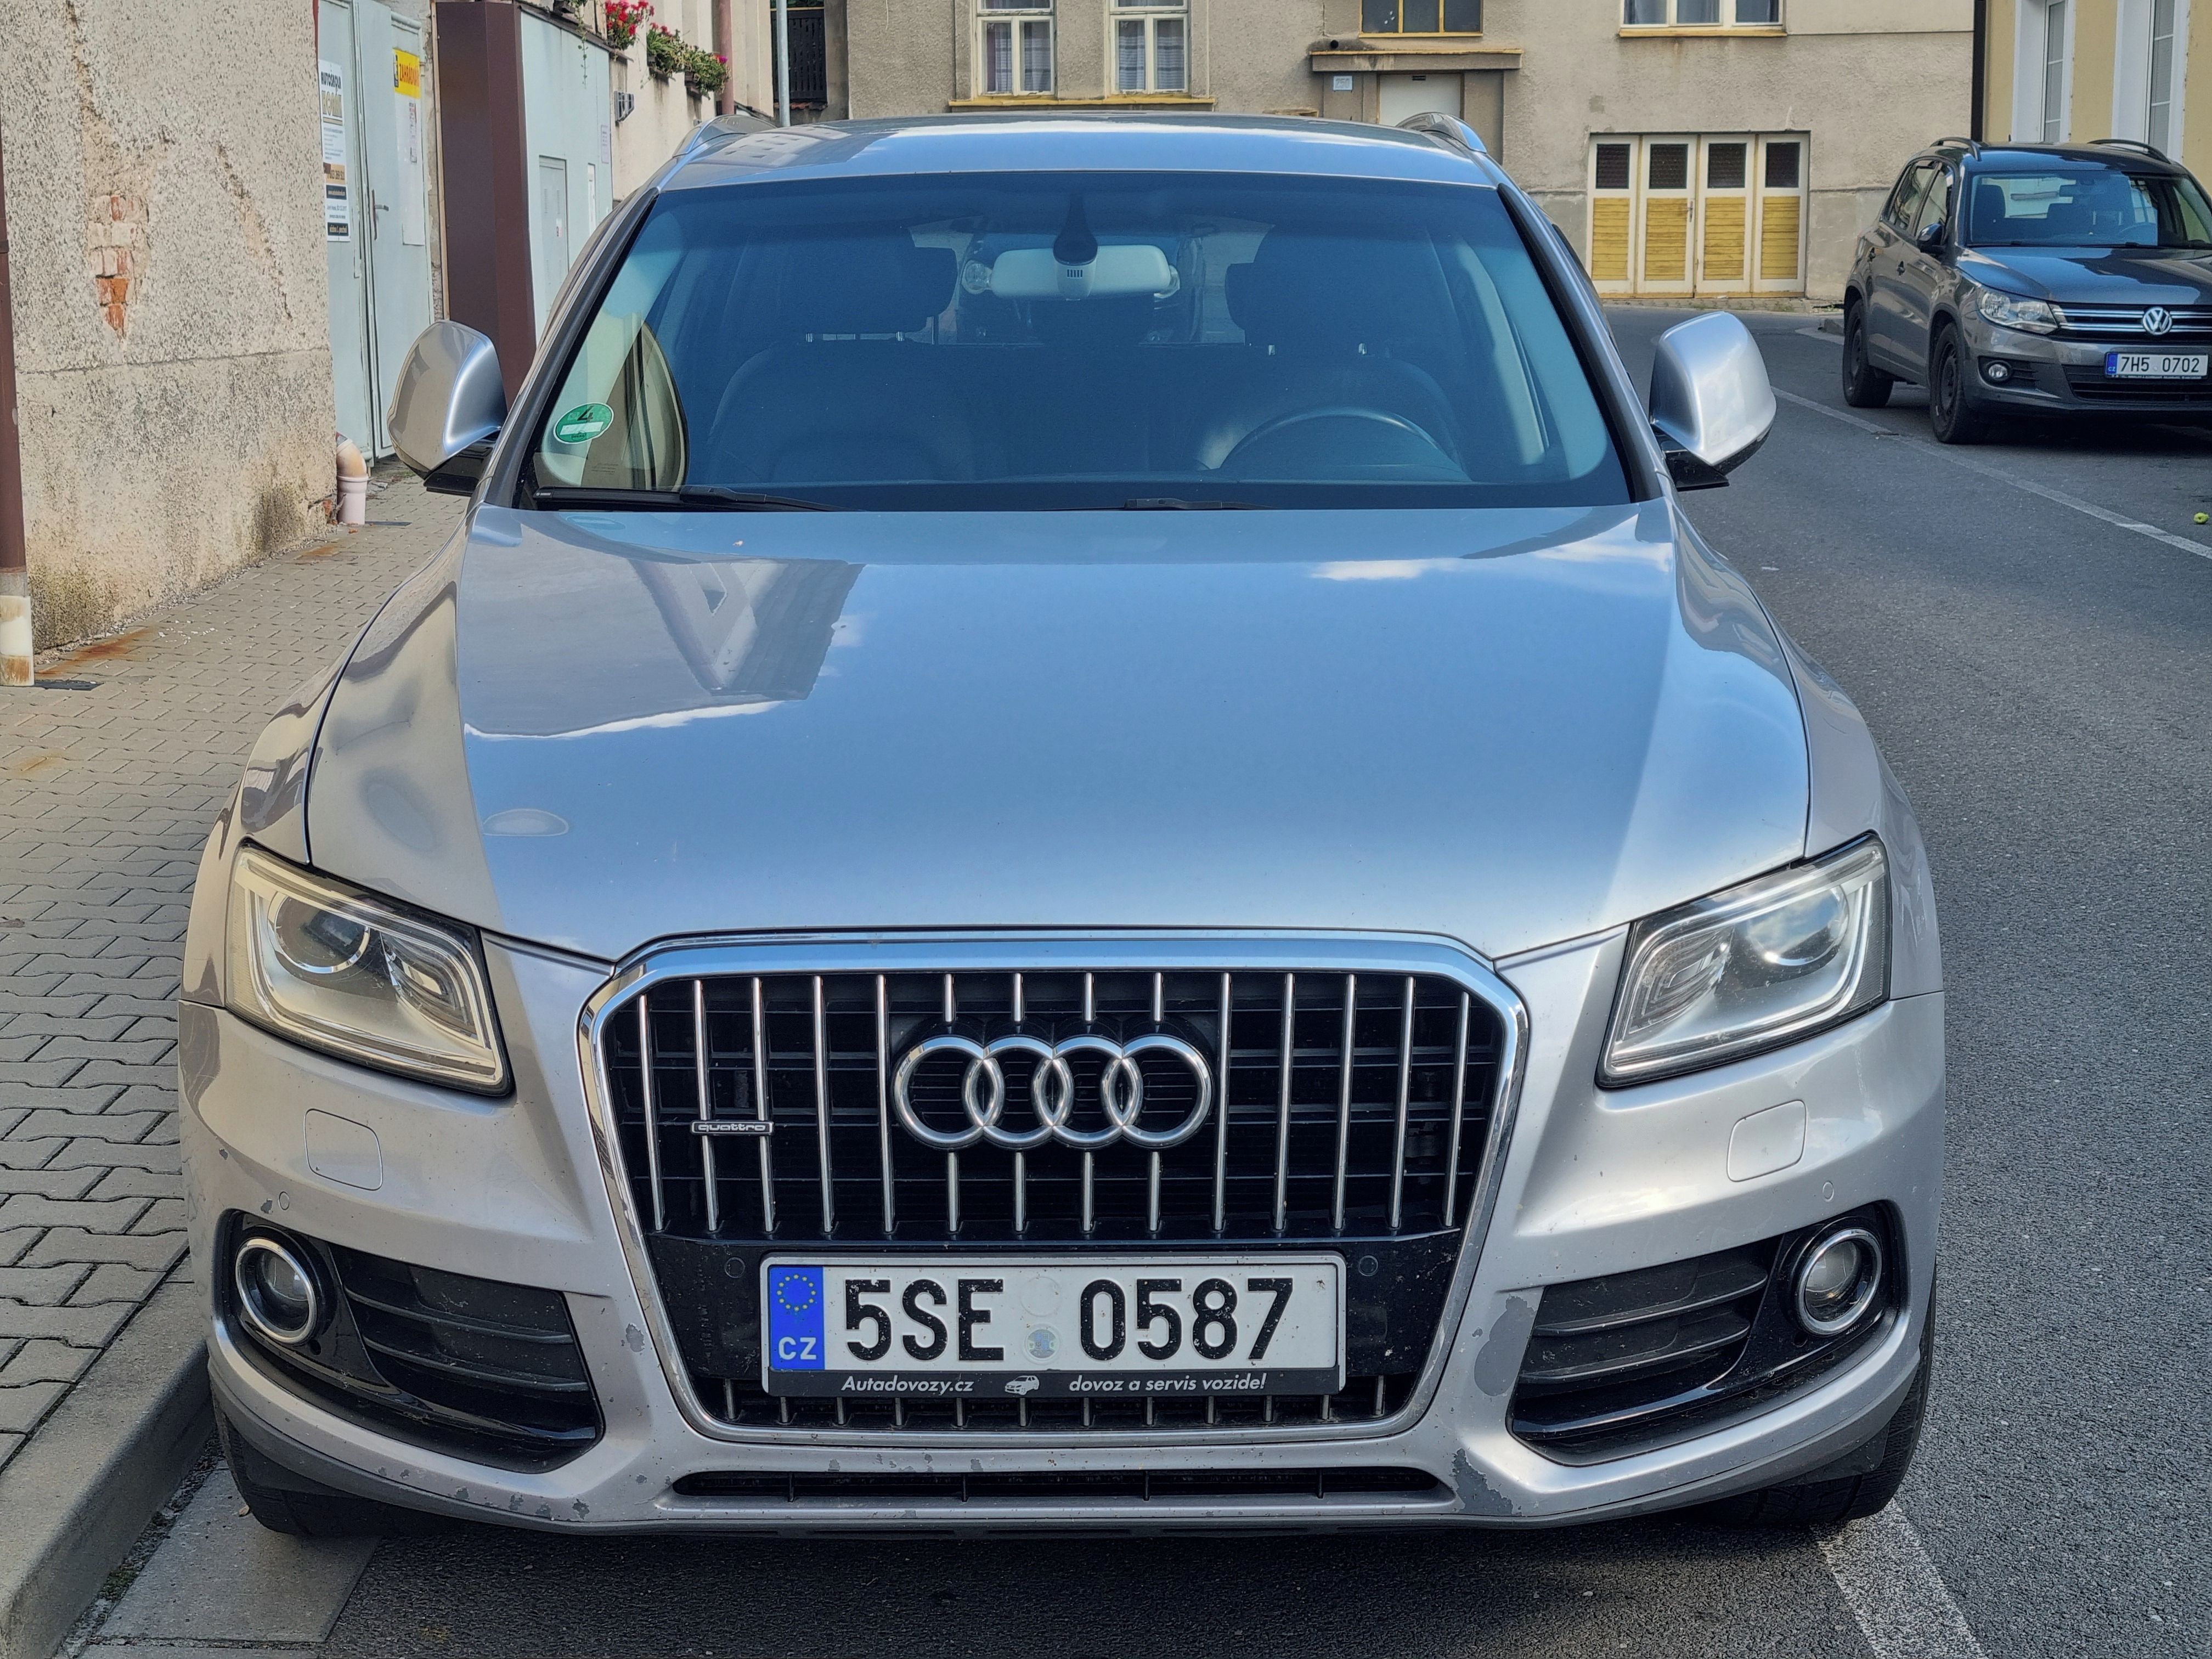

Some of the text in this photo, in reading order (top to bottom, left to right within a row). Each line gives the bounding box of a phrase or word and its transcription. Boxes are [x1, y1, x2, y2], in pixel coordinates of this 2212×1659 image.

[2120, 357, 2199, 373] 7H5 0702
[577, 405, 594, 422] 4
[698, 1124, 765, 1132] quattro
[845, 1277, 1293, 1362] 5SE 0587
[778, 1336, 817, 1361] CZ
[841, 1375, 974, 1396] Autadovozy.cz
[1070, 1373, 1267, 1391] dovoz a servis vozidel
